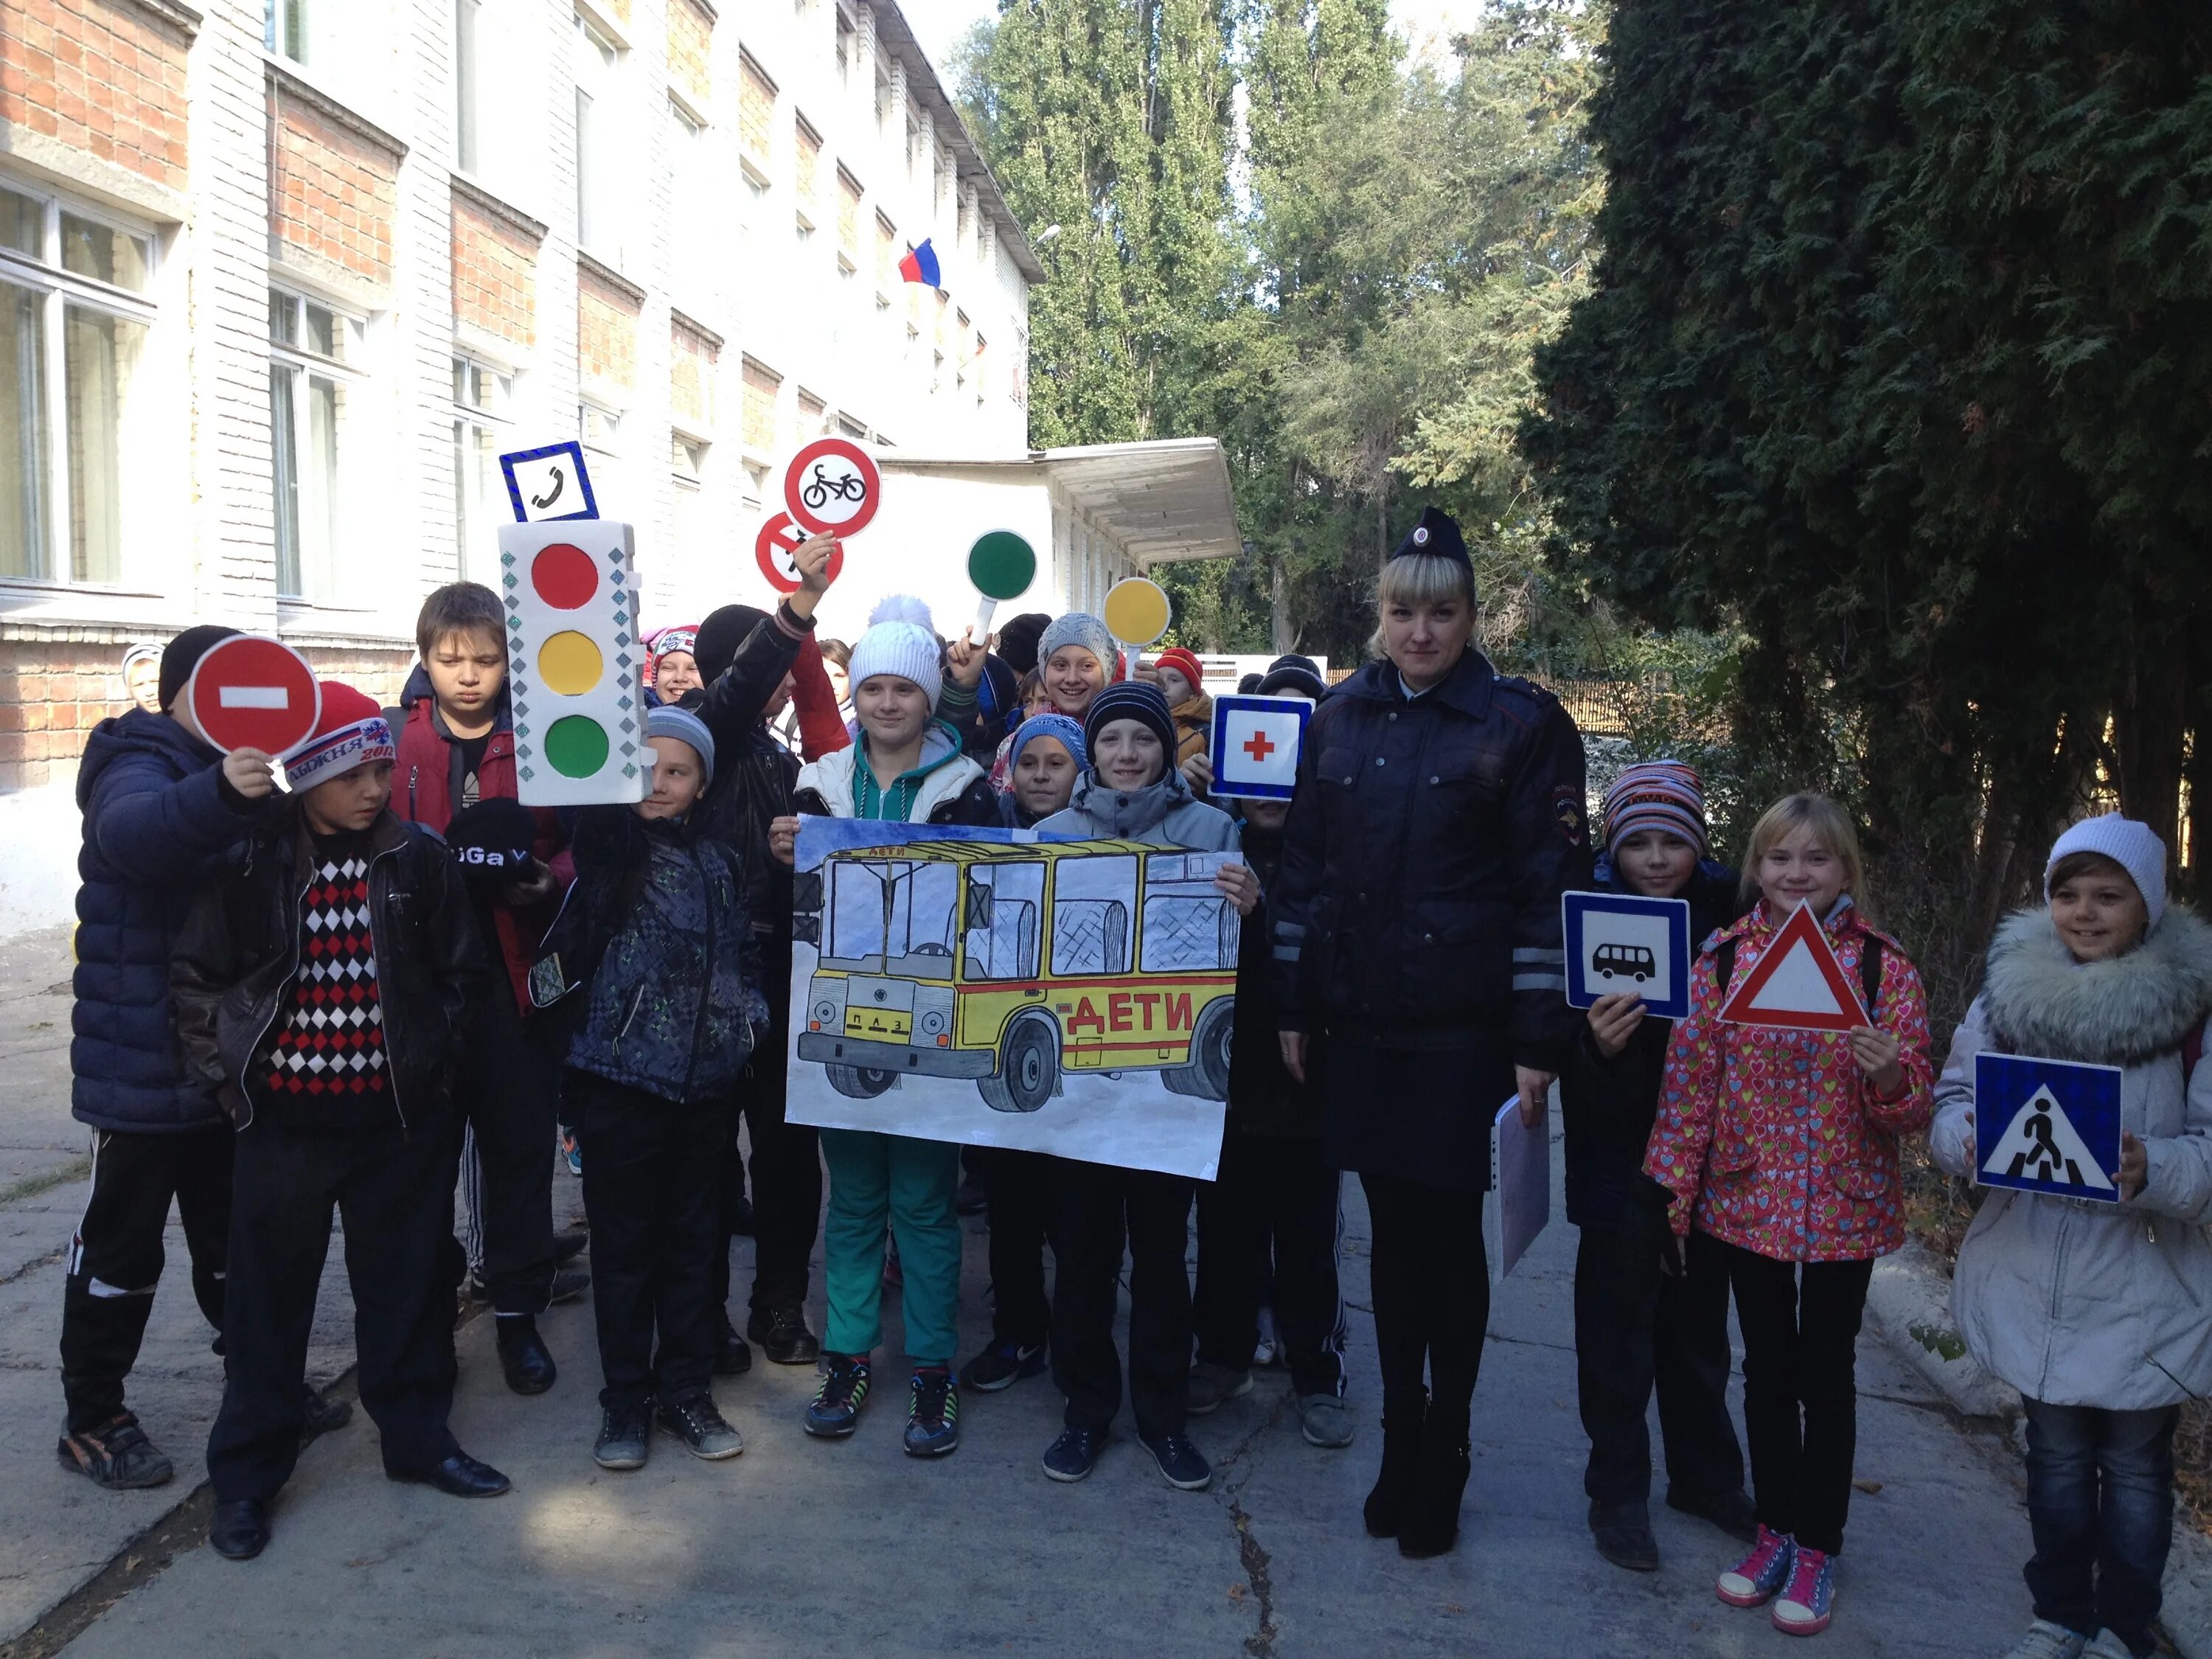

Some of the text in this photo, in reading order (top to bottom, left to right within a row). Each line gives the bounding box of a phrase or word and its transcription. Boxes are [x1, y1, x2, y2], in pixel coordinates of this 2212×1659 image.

[289, 737, 363, 783] ЛЫЖНЯ
[869, 847, 905, 857] ДЕТИ
[1067, 992, 1193, 1035] ДЕТИ
